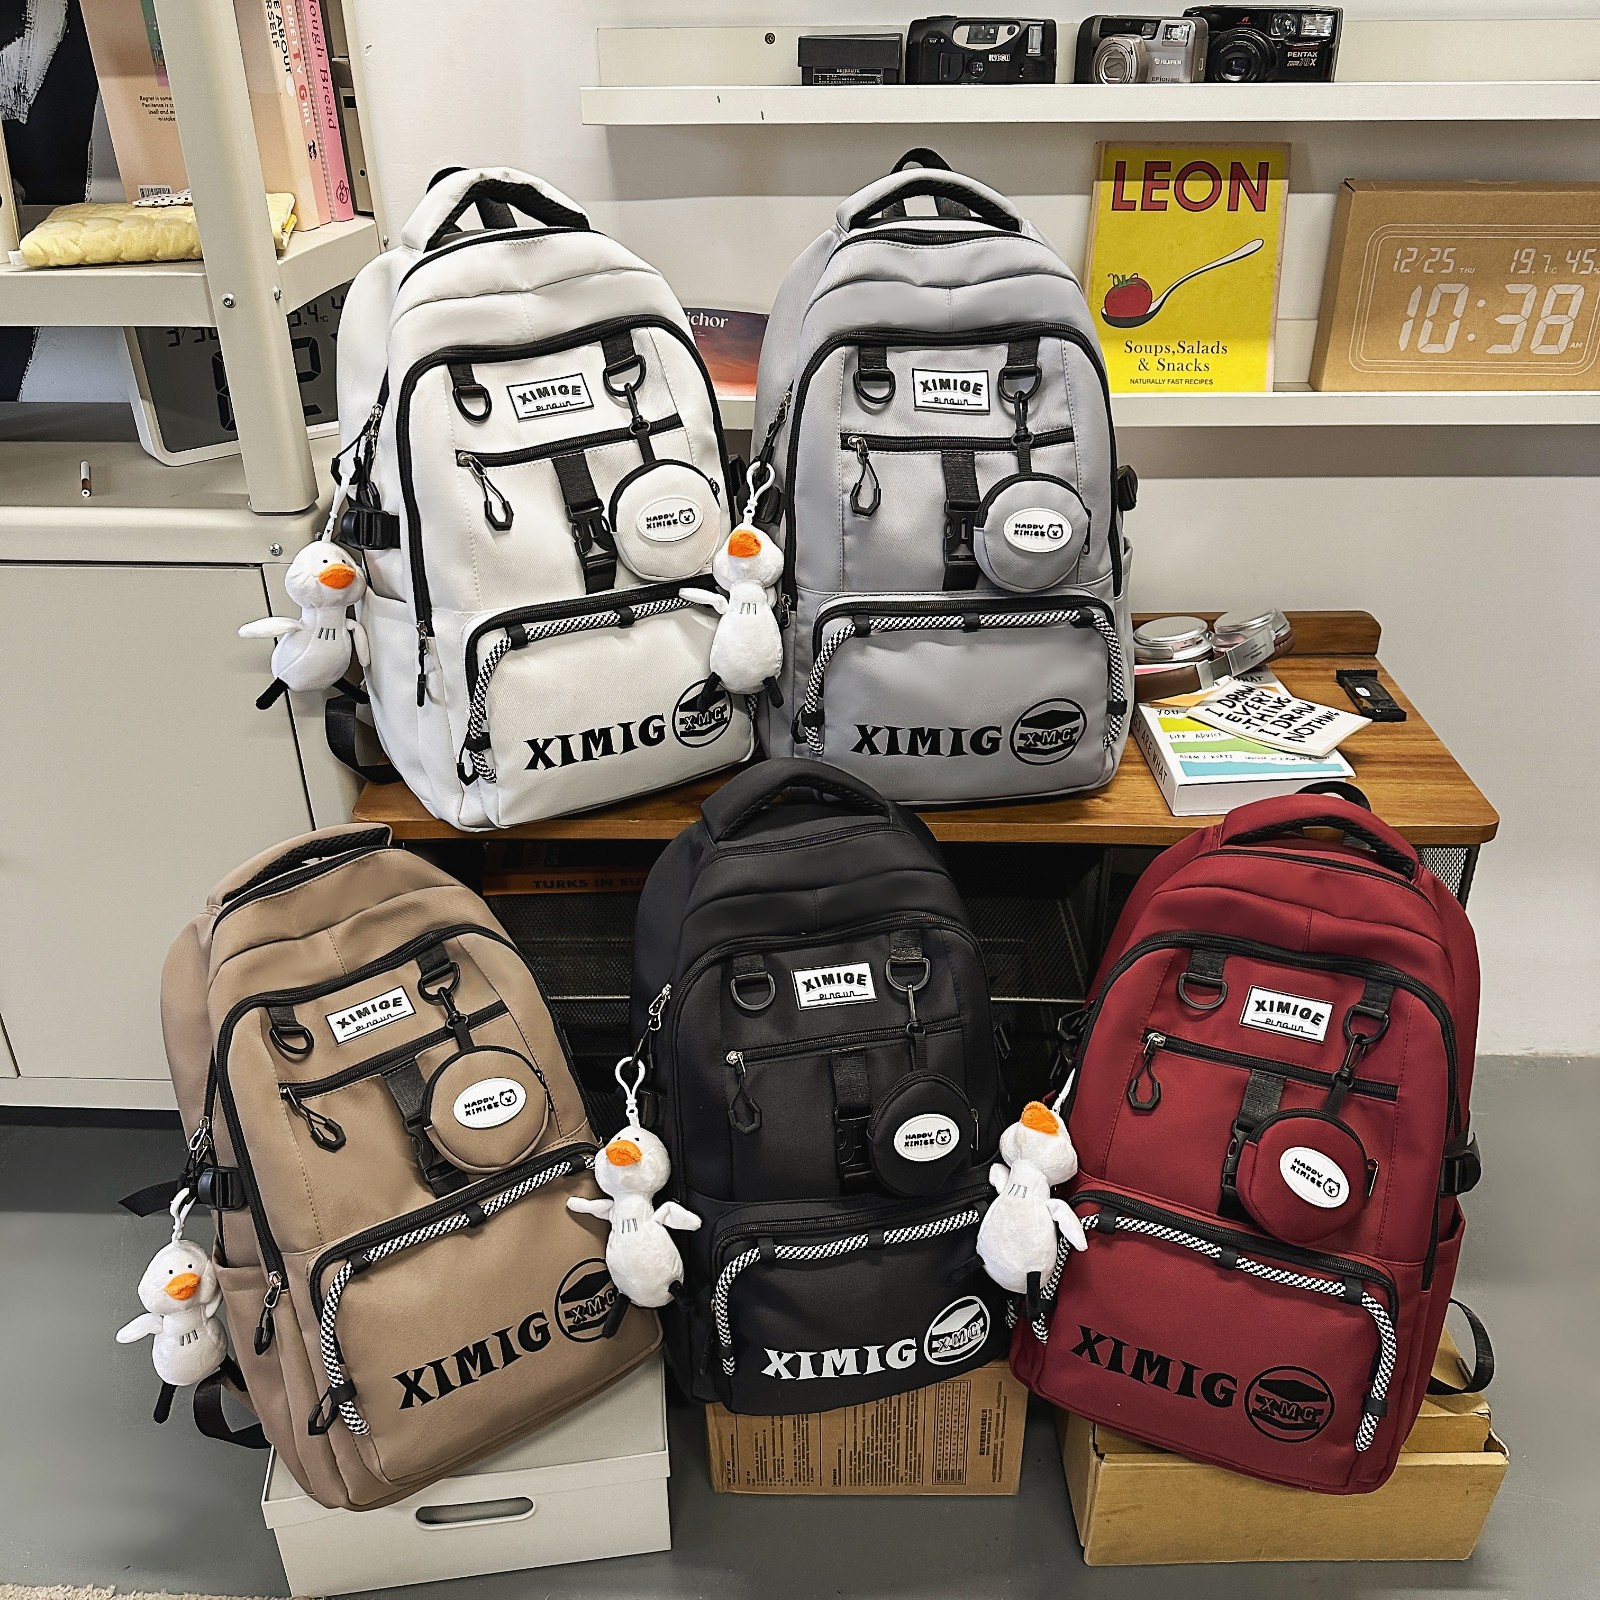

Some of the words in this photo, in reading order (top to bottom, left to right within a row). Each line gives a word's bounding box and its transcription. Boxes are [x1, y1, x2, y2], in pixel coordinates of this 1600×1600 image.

[275, 15, 293, 75] ABOUT
[285, 4, 303, 75] PRETTY
[298, 84, 311, 128] GIRL
[319, 68, 338, 130] Bread
[1110, 160, 1270, 213] LEON
[1393, 247, 1457, 274] 12/25
[1398, 283, 1585, 355] 10:38
[1569, 341, 1584, 350] AM
[1137, 357, 1151, 372] &
[1155, 357, 1211, 372] Snacks
[516, 383, 582, 406] XIMIGE
[919, 377, 984, 397] XIMIGE
[1184, 378, 1214, 386] RECIPES
[1205, 708, 1224, 718] I
[1216, 684, 1256, 709] DRAW
[1225, 691, 1273, 723] EVERY
[1269, 701, 1317, 730] DRAW
[523, 712, 667, 771] XIMIG
[850, 723, 1003, 758] XIMIG
[1258, 728, 1281, 737] I
[1141, 730, 1153, 757] ARE
[1152, 750, 1168, 785] WHAT
[532, 878, 589, 890] TURKS
[802, 972, 868, 992] XIMIGE
[335, 996, 403, 1031] XIMIGE
[1254, 999, 1325, 1027] XIMIGE
[391, 1309, 553, 1411] XIMIG
[760, 1337, 918, 1381] XIMIG
[1070, 1323, 1239, 1409] XIMIG
